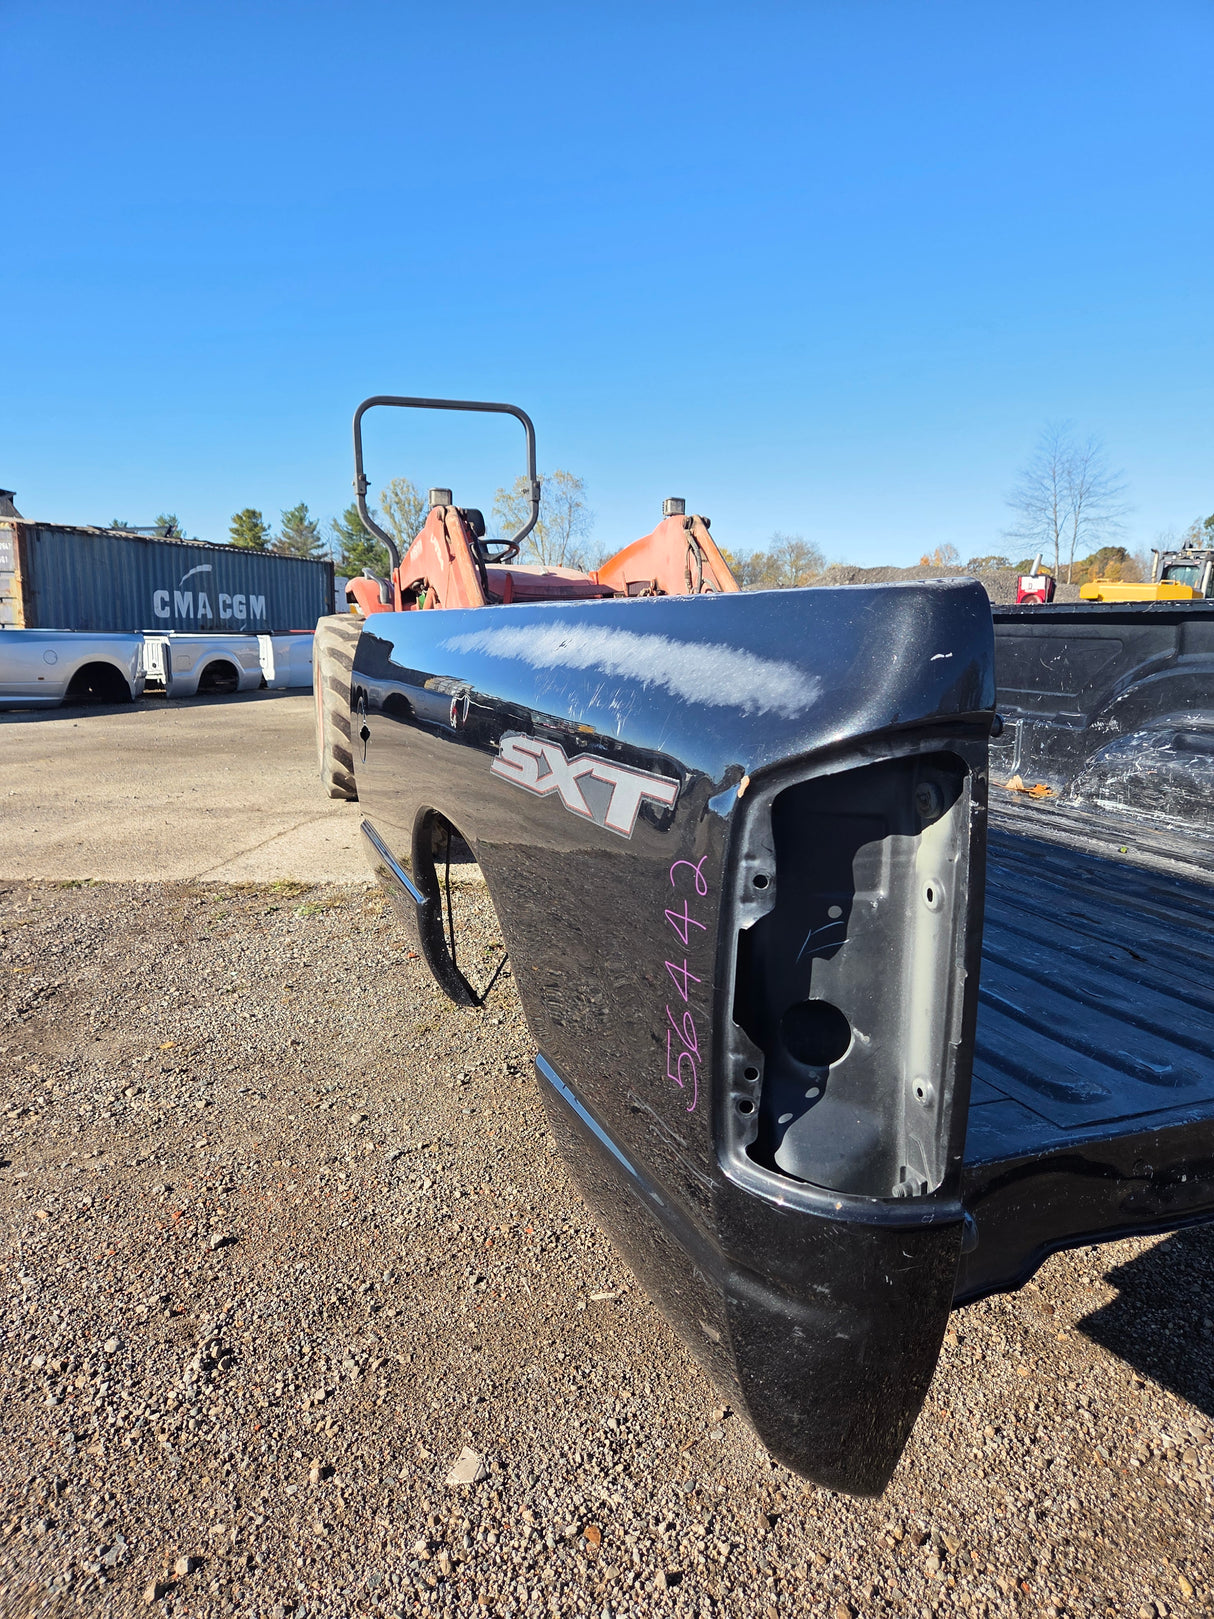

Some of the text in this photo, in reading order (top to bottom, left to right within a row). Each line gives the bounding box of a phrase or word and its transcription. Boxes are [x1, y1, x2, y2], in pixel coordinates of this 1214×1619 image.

[153, 589, 266, 620] CMA CGM
[490, 731, 680, 839] SXT
[665, 855, 708, 1111] 56442
